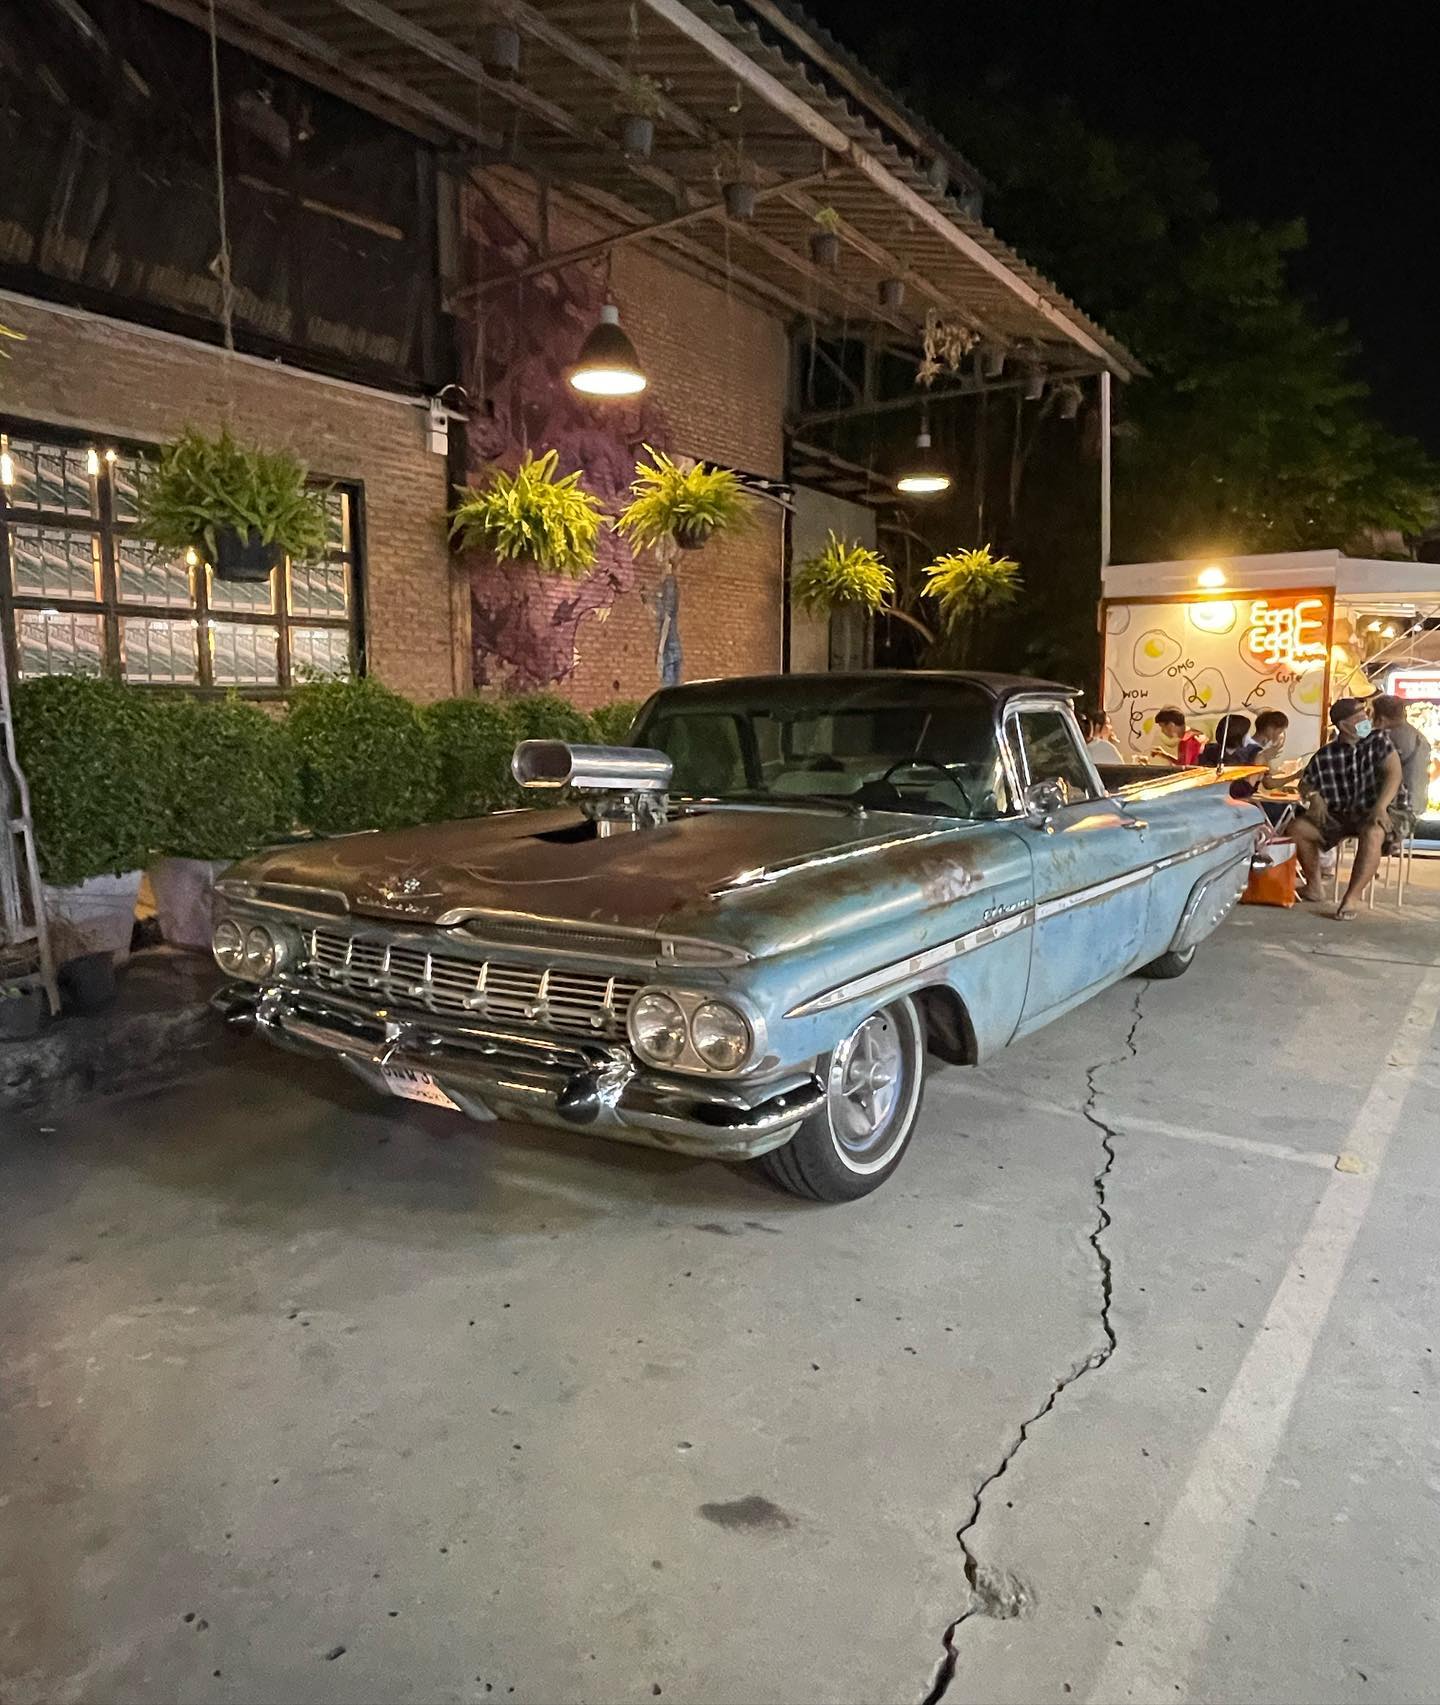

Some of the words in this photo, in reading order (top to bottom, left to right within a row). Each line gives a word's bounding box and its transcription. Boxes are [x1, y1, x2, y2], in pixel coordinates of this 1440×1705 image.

[1167, 658, 1195, 677] OMG
[1275, 671, 1303, 684] Cute
[1123, 689, 1149, 699] WOW
